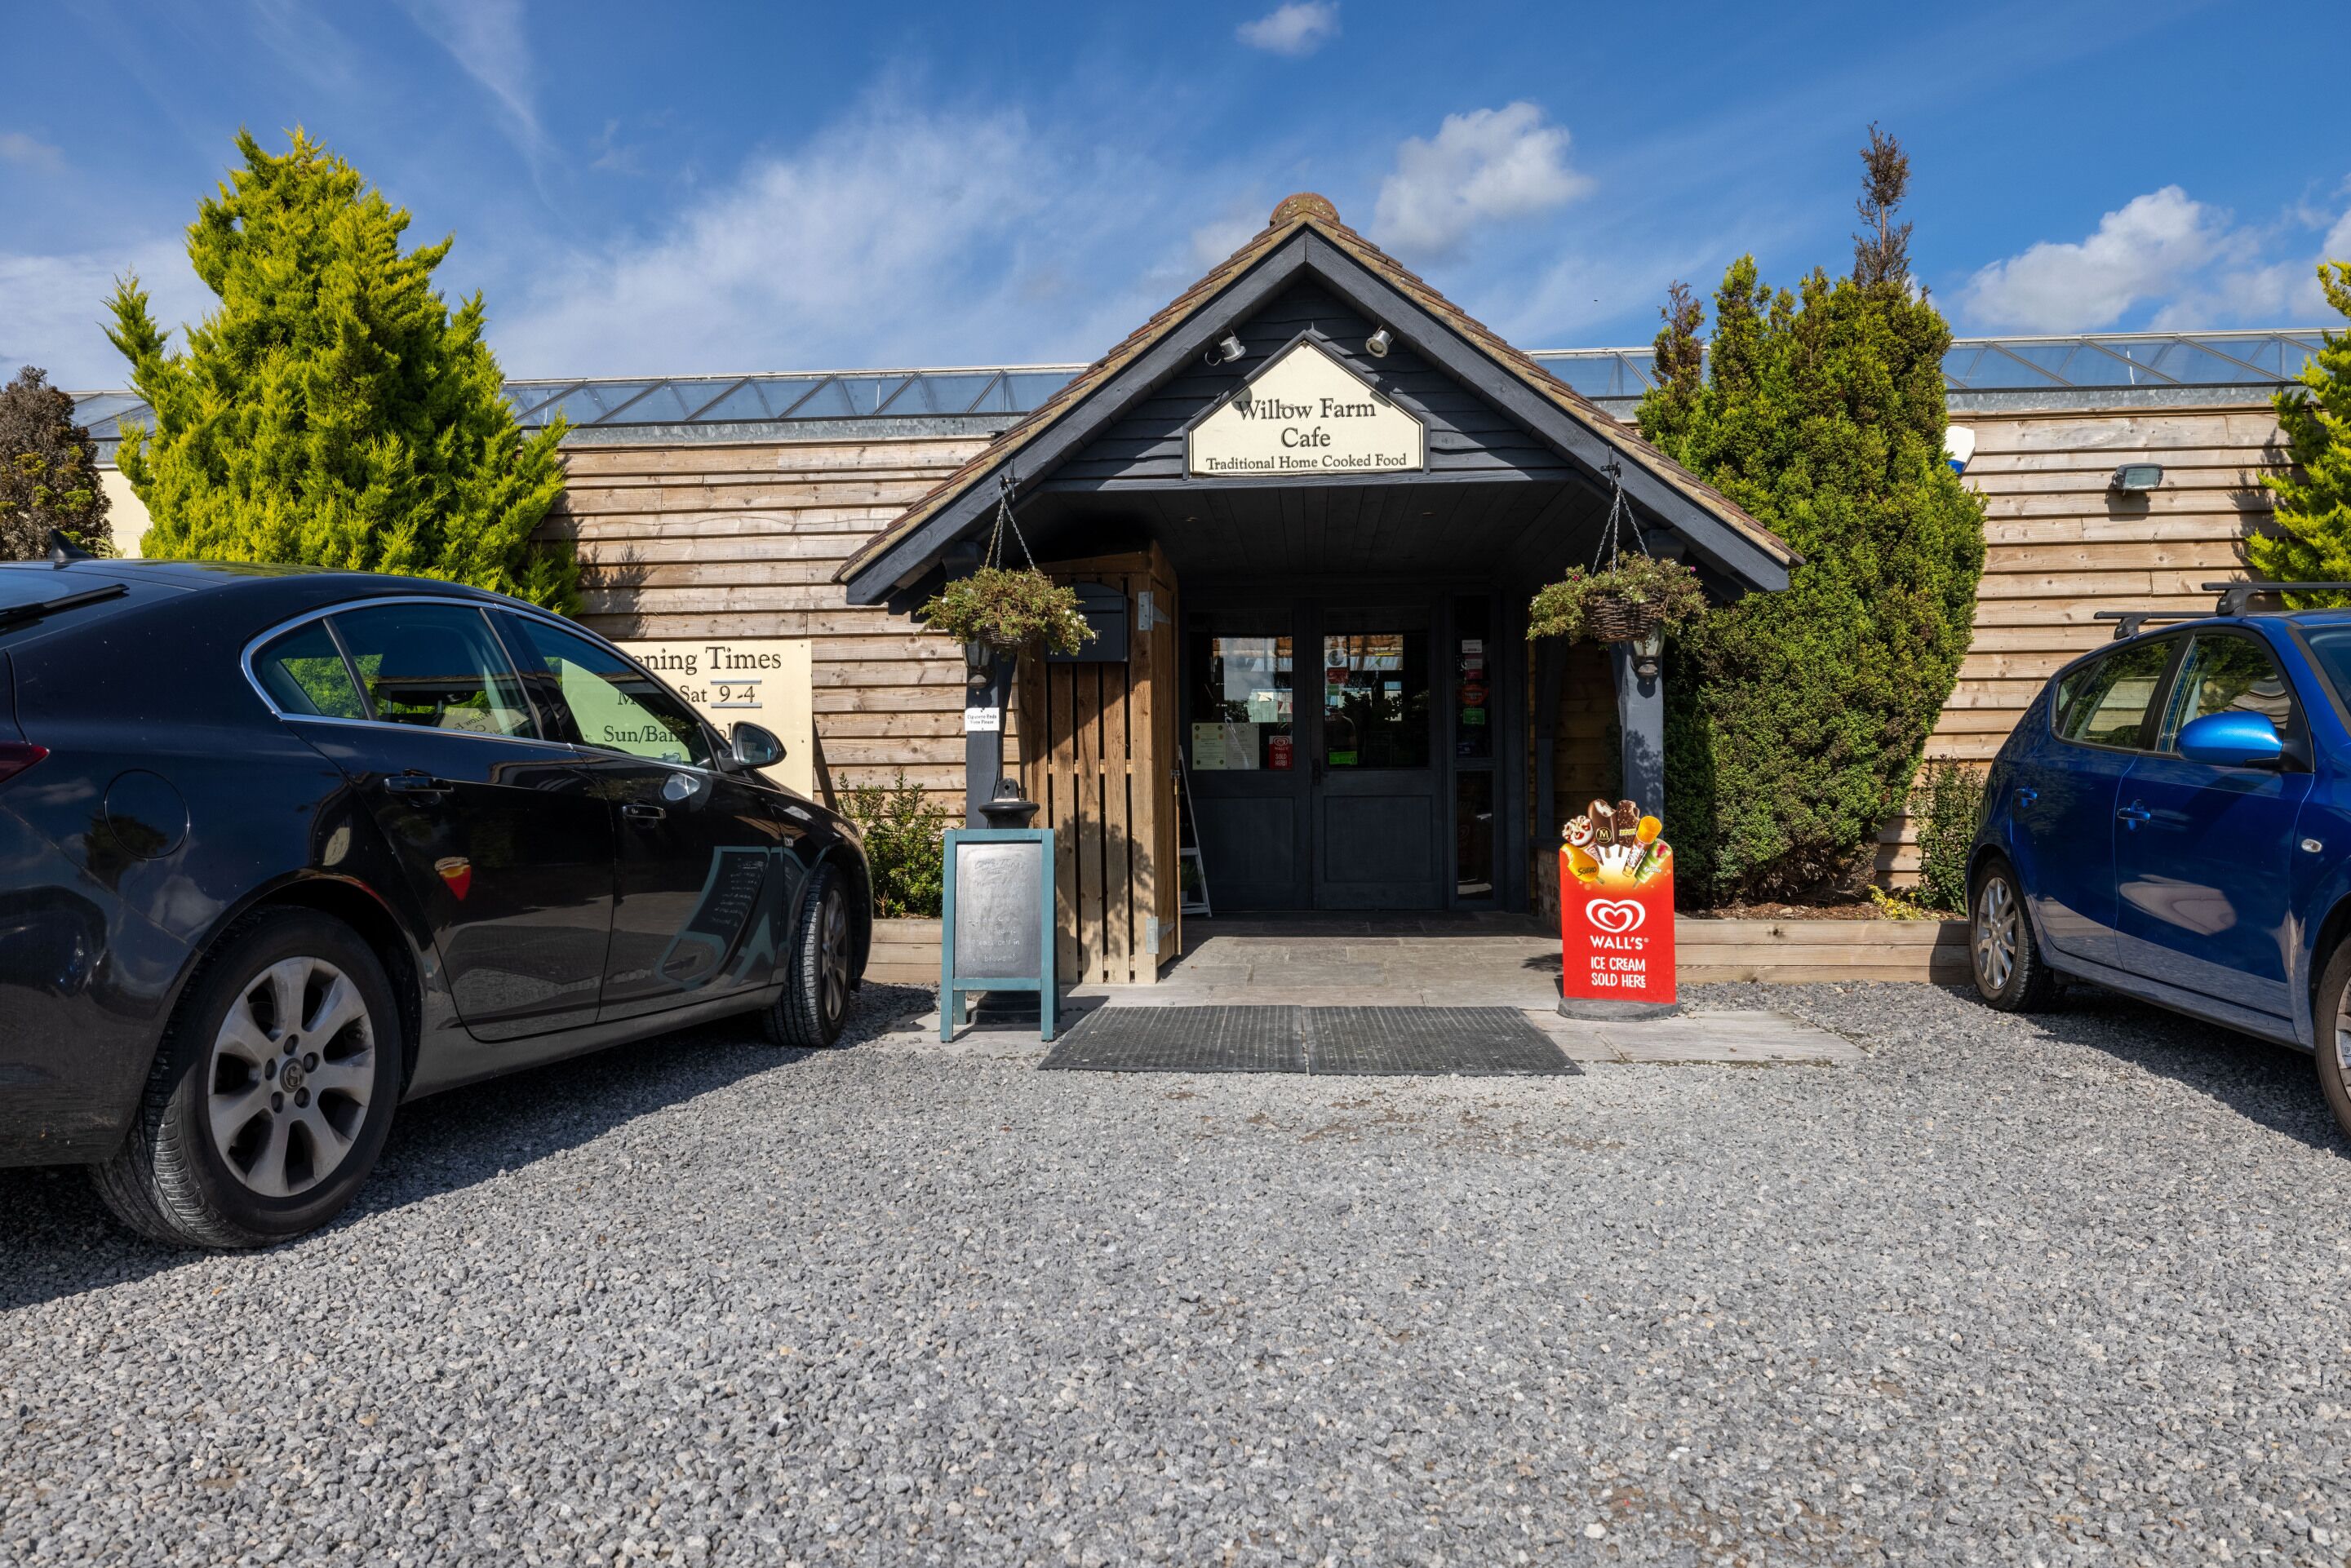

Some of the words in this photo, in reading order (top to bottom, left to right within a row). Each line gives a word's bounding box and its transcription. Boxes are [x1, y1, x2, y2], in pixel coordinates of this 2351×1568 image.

[1235, 399, 1312, 421] Willow
[1320, 397, 1377, 419] Farm
[1280, 426, 1331, 448] Cafe
[1205, 457, 1275, 471] Traditional
[1279, 455, 1318, 469] Home
[1322, 454, 1371, 467] Cooked
[1375, 453, 1407, 467] Food
[705, 646, 782, 670] Times
[679, 684, 708, 702] Sat
[719, 685, 730, 702] 9
[603, 725, 680, 743] Sun/Ban
[1590, 956, 1606, 970] ICE
[1609, 957, 1645, 972] CREAM
[1590, 972, 1617, 986] SOLD
[1621, 974, 1646, 989] HERE
